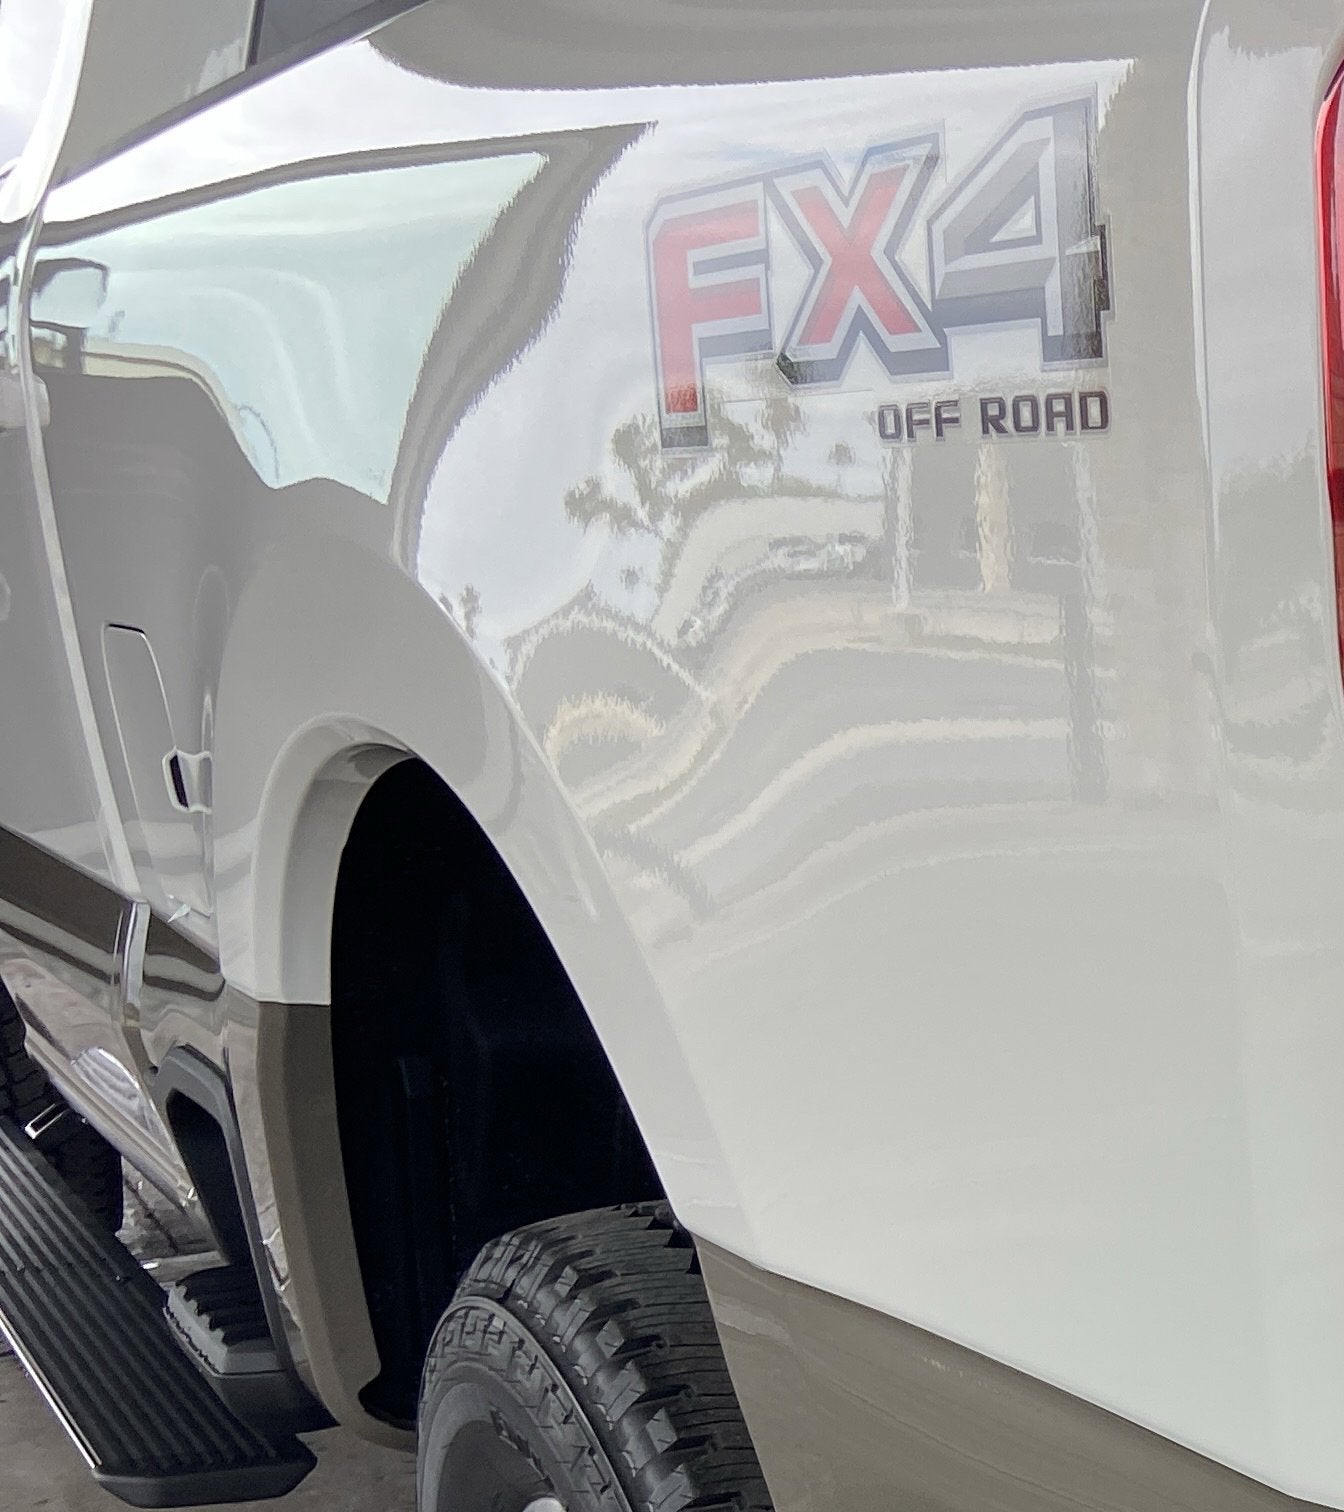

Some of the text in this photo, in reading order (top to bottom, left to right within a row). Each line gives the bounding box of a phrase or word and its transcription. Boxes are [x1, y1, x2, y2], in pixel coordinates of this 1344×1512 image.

[645, 94, 1111, 451] FX4
[877, 390, 1110, 441] OFF ROAD
